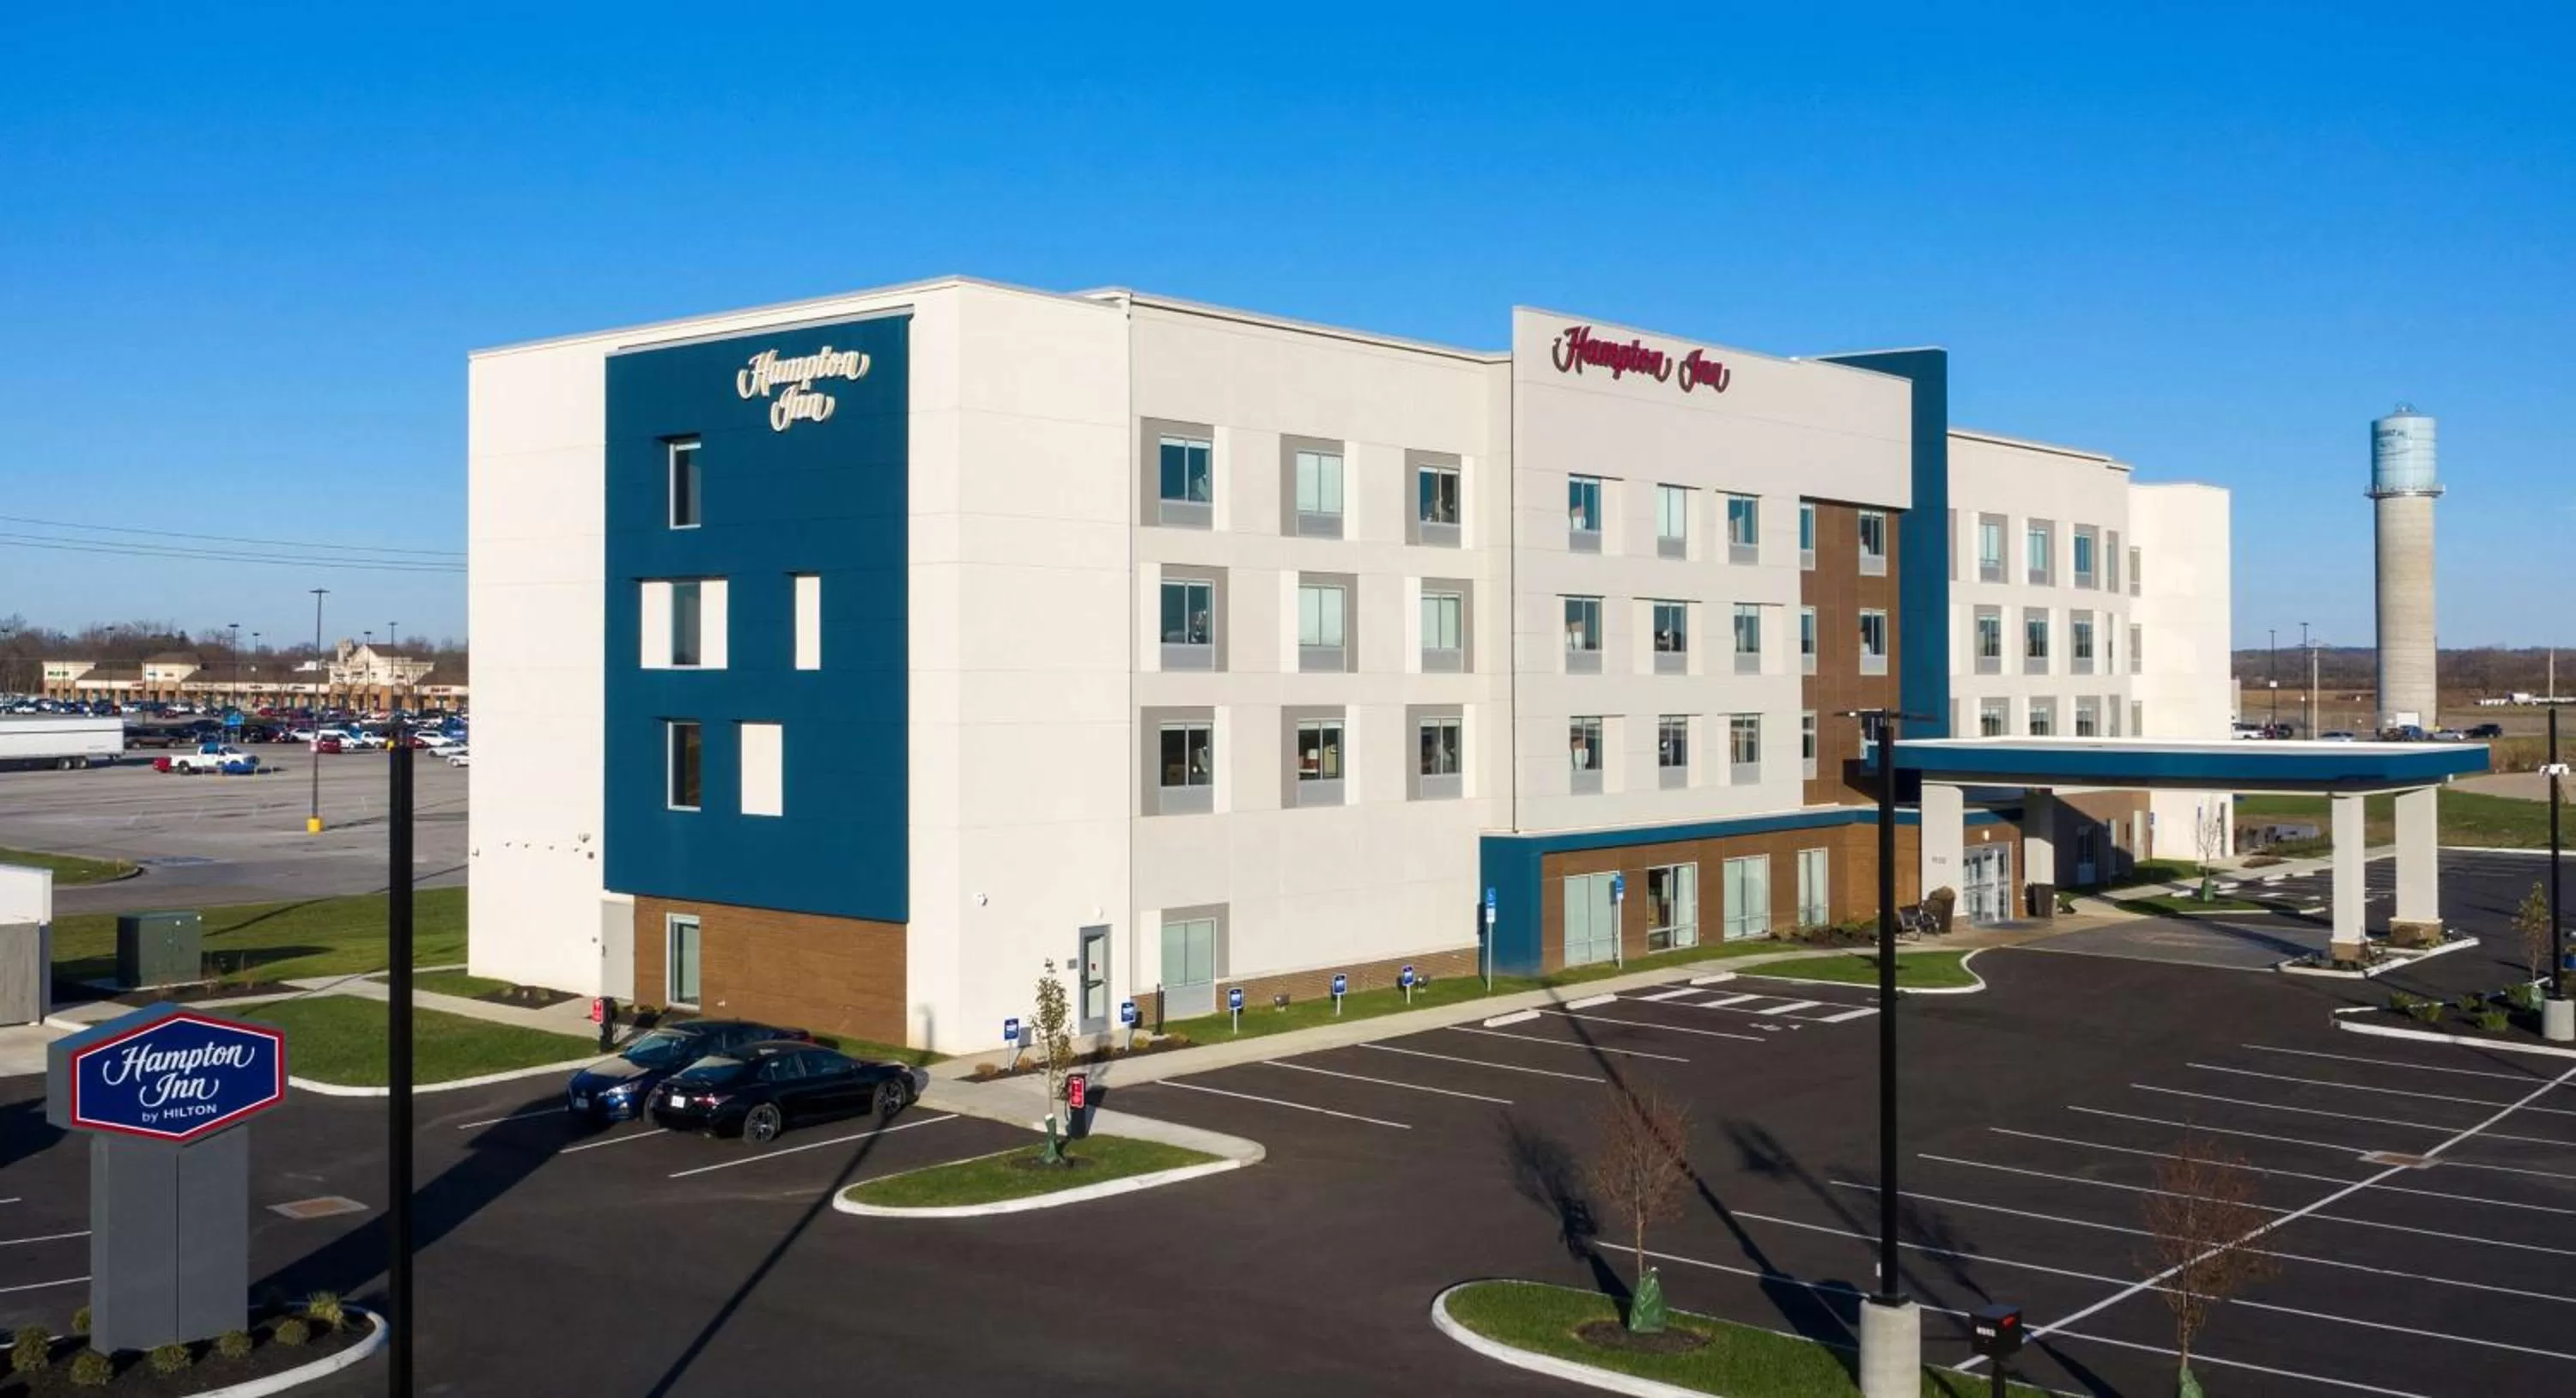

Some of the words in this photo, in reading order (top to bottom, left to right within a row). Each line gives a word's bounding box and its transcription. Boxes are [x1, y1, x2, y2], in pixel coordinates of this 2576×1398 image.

[737, 345, 871, 399] Hampton
[1552, 325, 1673, 383] Hampton
[1678, 348, 1731, 393] Inn
[770, 385, 835, 431] Inn
[102, 1041, 255, 1085] Hampton
[138, 1073, 220, 1108] Inn
[142, 1111, 159, 1124] by
[163, 1103, 217, 1119] HILTON
